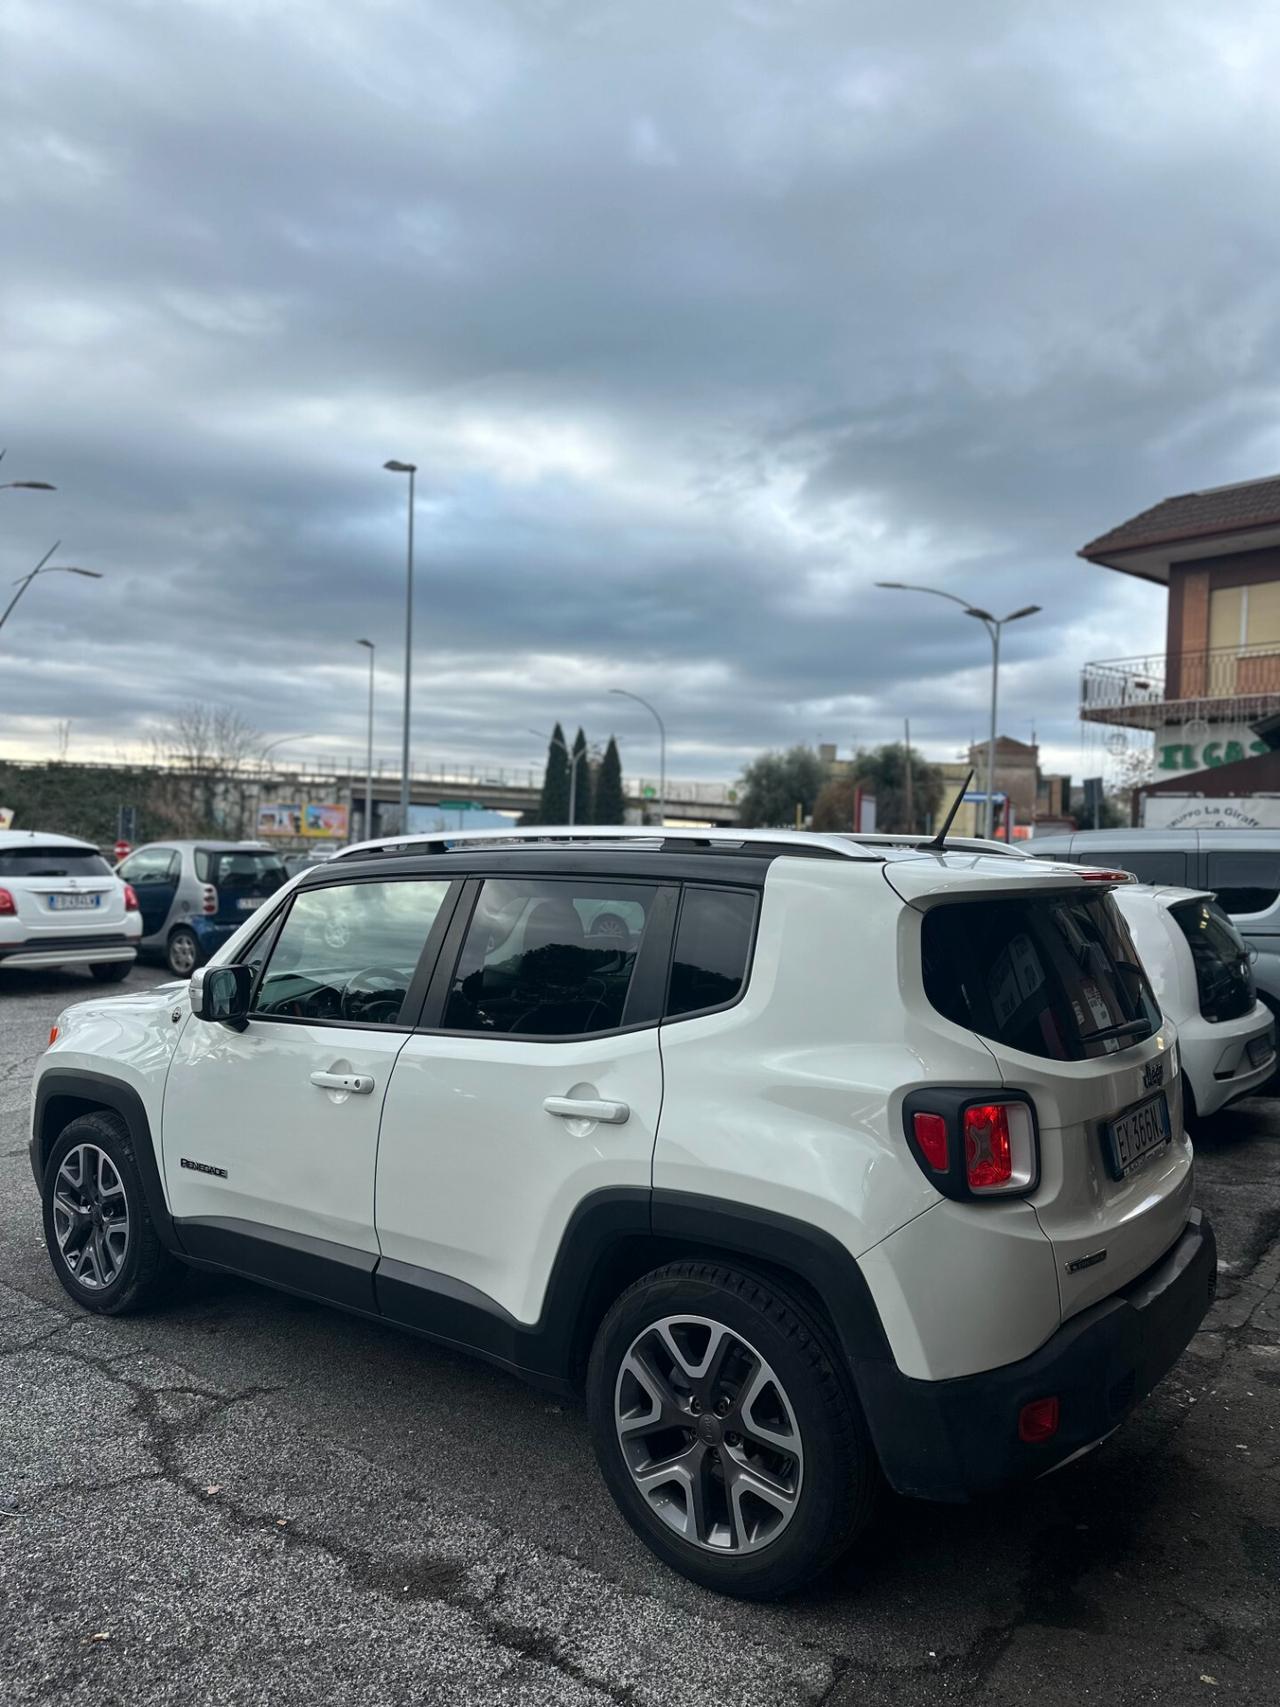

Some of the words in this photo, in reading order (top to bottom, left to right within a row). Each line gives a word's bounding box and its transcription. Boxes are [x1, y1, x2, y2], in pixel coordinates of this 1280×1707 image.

[1204, 805, 1220, 815] La
[1116, 1121, 1132, 1163] EY
[180, 1157, 228, 1180] RENEGADE
